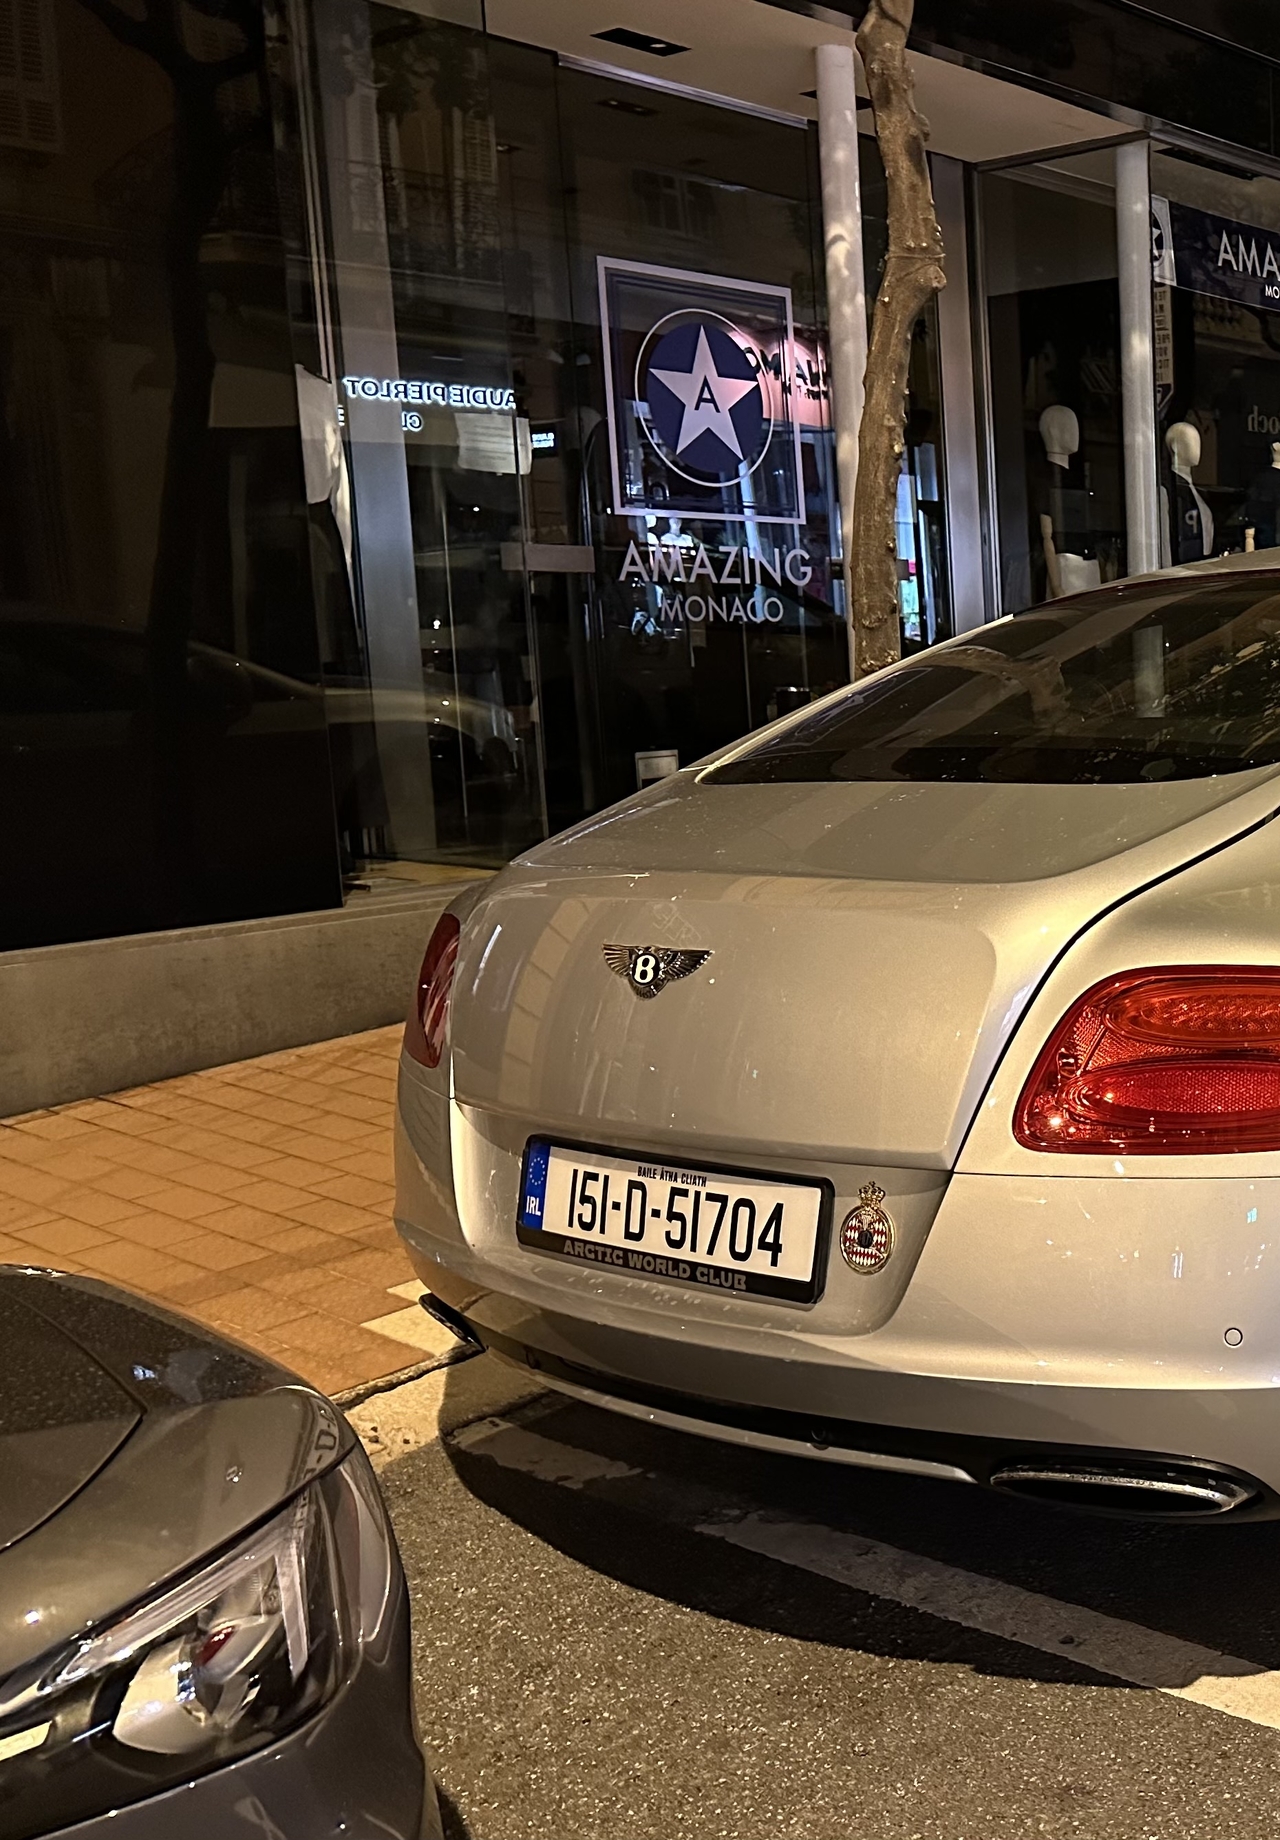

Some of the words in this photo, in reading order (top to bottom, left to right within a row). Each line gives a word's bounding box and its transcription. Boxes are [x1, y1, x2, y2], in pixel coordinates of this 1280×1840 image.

[694, 374, 721, 413] A
[618, 539, 813, 588] AMAZING
[660, 594, 784, 624] MONACO
[637, 1166, 658, 1179] BAILE
[681, 1173, 707, 1187] CLIATH
[525, 1195, 541, 1217] IRL
[568, 1168, 785, 1268] 151-D-51704
[563, 1240, 623, 1265] ARCTIC
[628, 1253, 691, 1279] WORLD
[696, 1267, 747, 1291] CLUB
